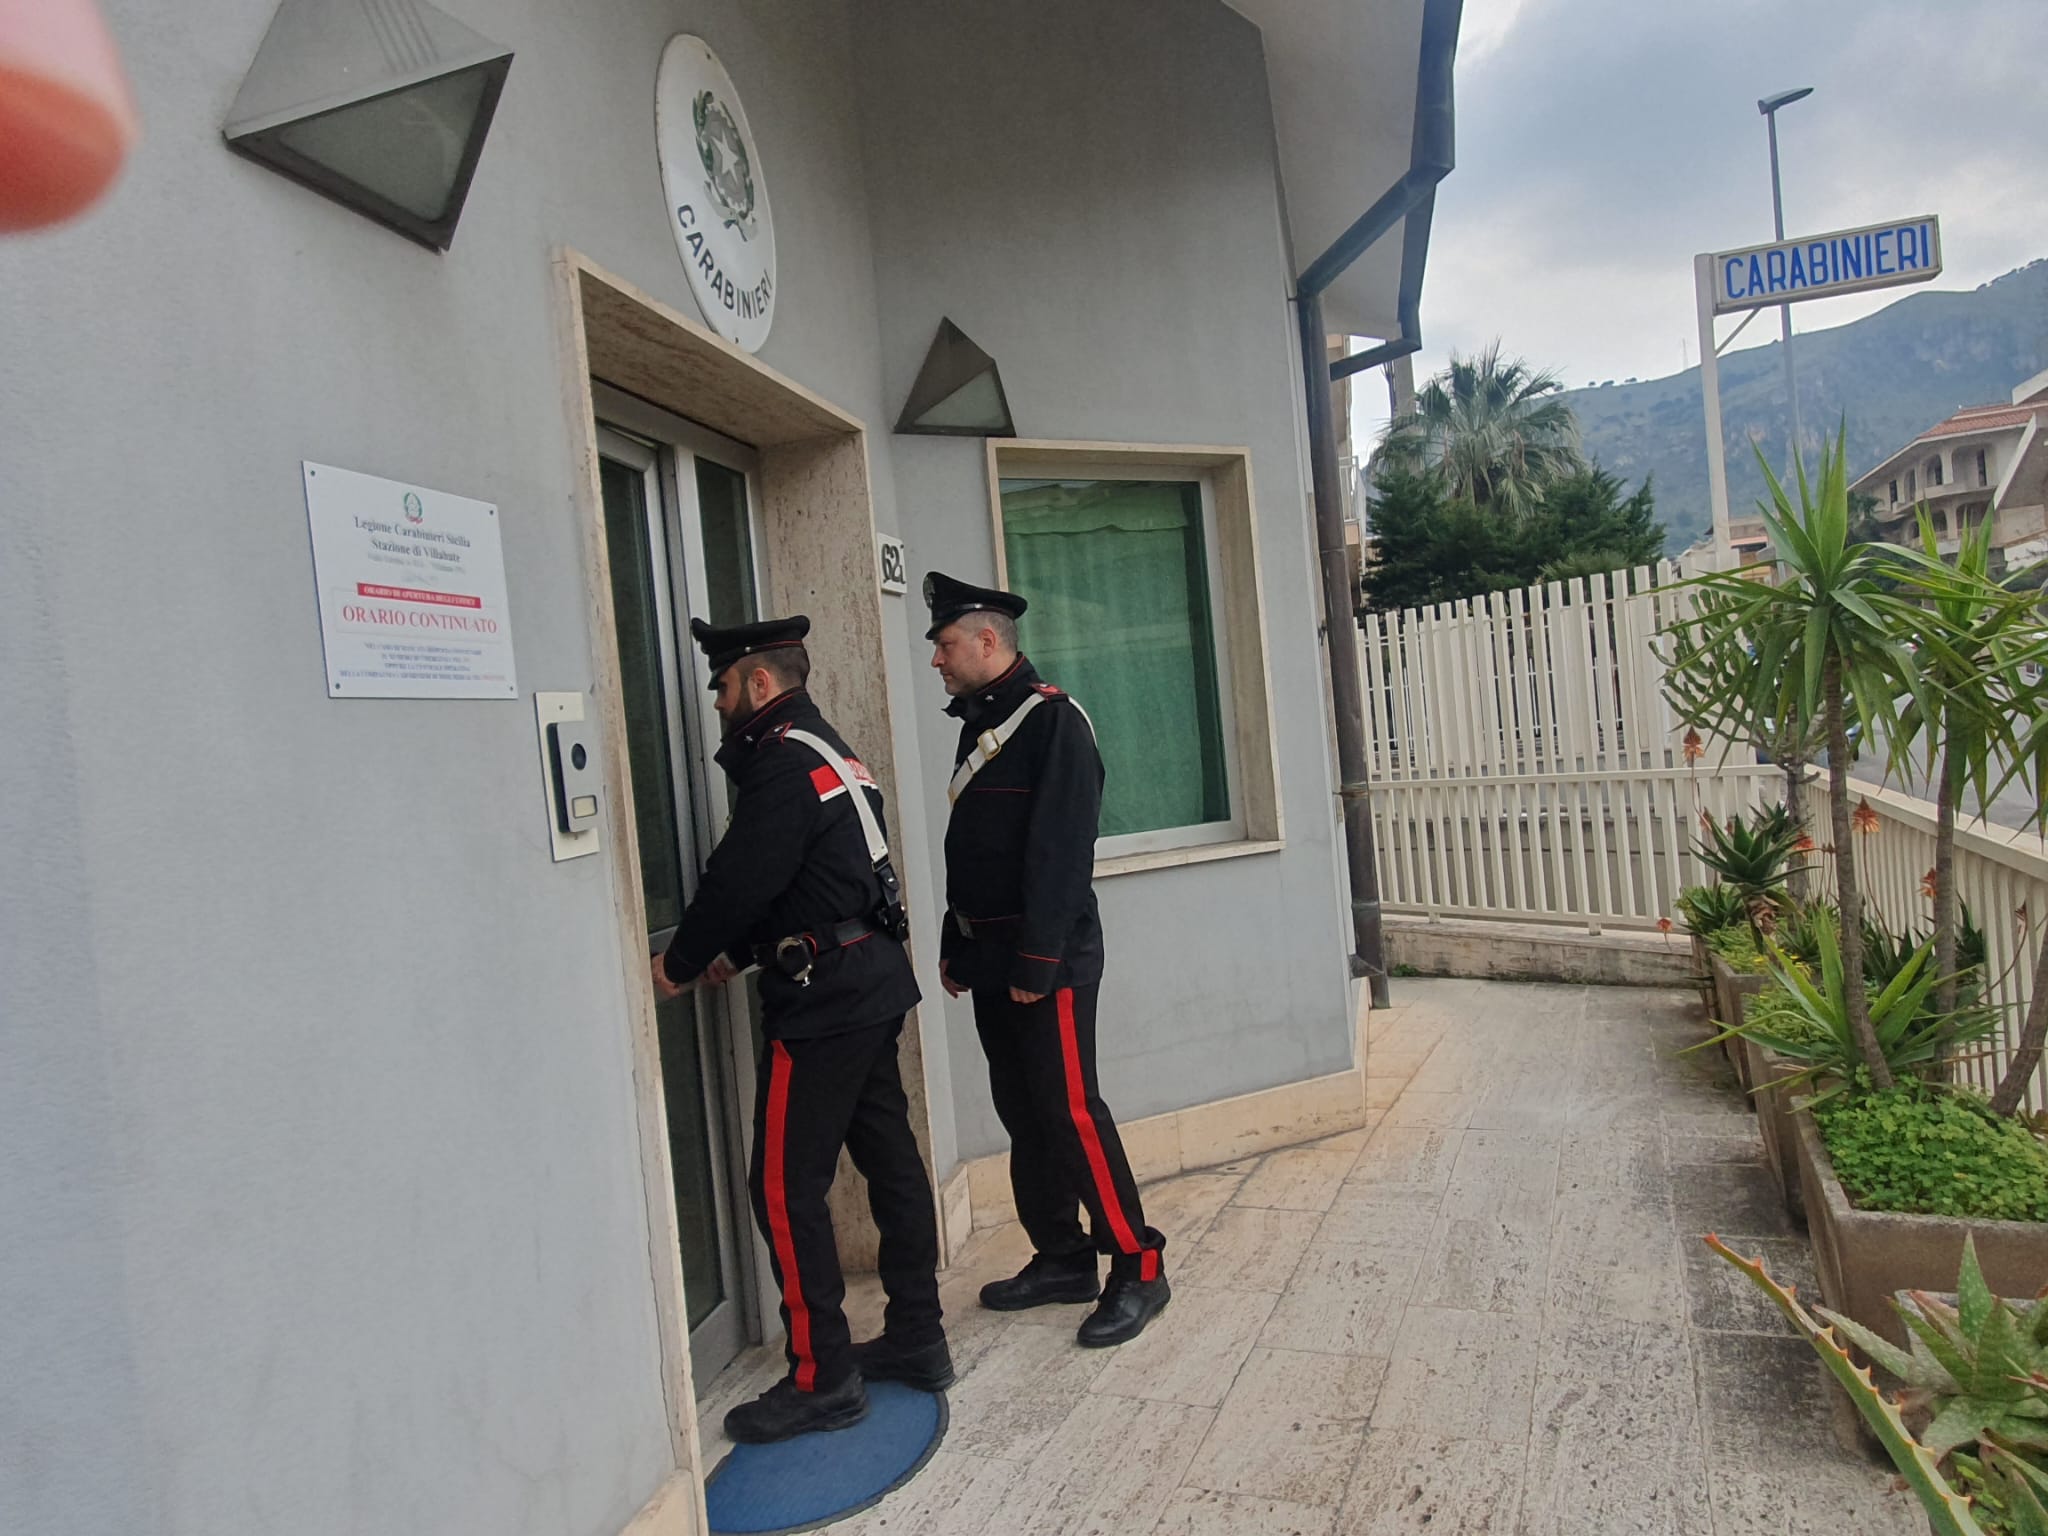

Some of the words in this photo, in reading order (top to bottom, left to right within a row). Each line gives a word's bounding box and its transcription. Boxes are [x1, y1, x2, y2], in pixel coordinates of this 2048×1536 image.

[677, 204, 773, 320] CARABINIERI
[1725, 224, 1930, 299] CARABINIERI
[354, 516, 392, 534] Legione
[394, 523, 445, 543] Carabinieri
[446, 532, 471, 548] Sicilia
[371, 539, 410, 555] Stazione
[412, 545, 422, 557] di
[343, 605, 406, 626] ORARIO
[409, 611, 498, 634] CONTINUATO
